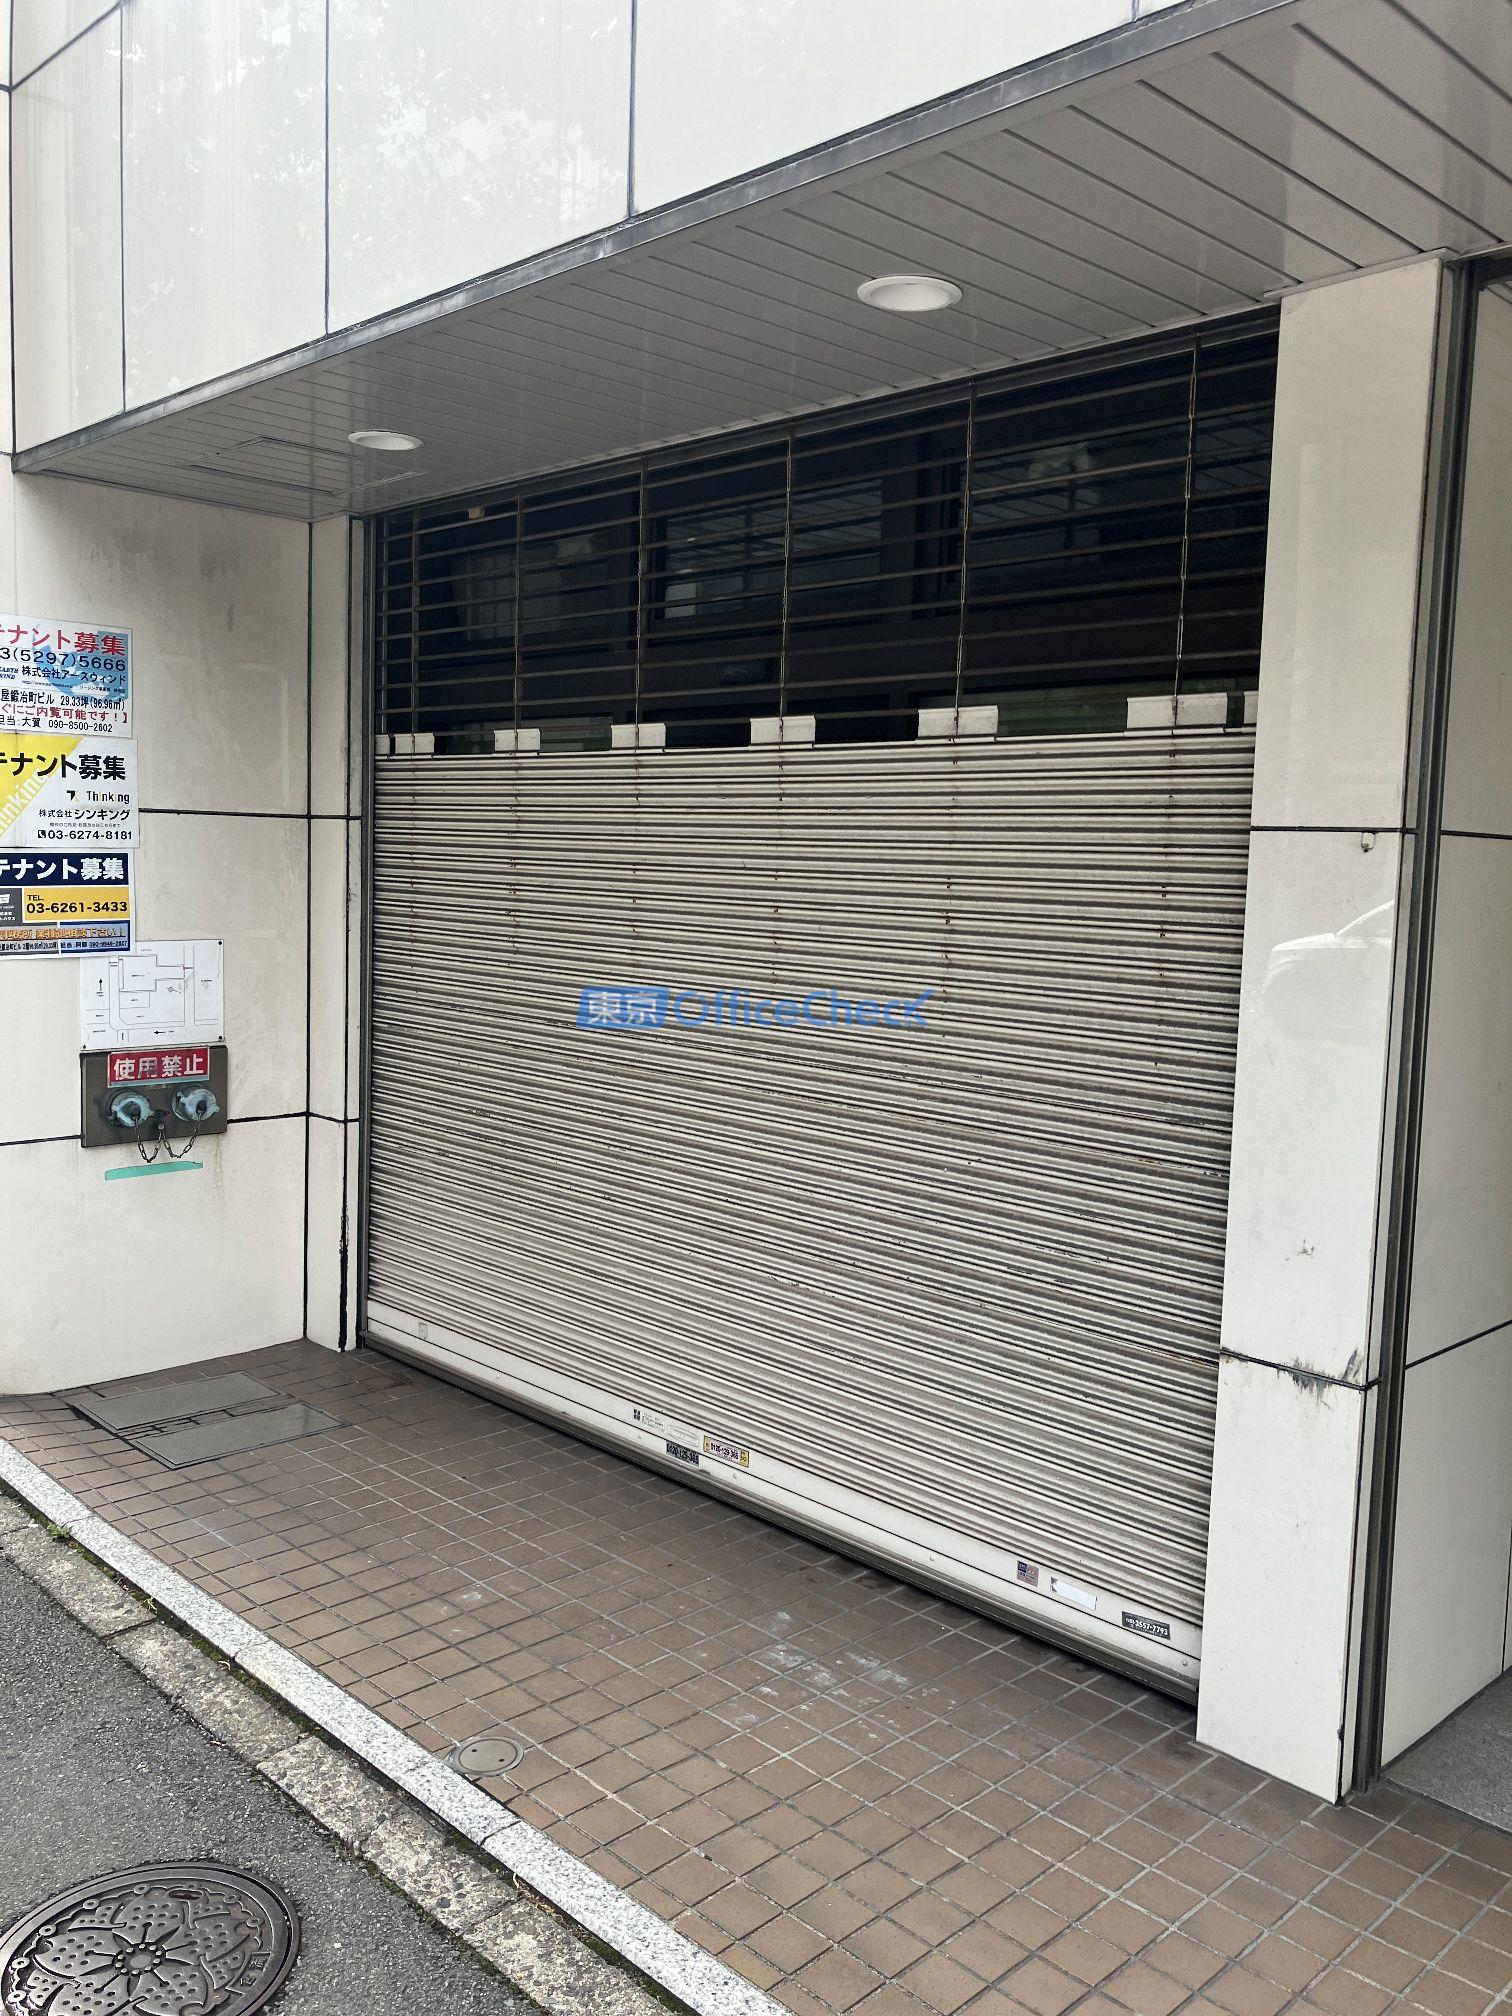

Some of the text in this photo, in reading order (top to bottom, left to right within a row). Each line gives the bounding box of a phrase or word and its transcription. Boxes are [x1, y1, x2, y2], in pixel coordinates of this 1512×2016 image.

[22, 665, 126, 686] 株式会社アースウィンド
[87, 791, 130, 804] Thinking
[38, 808, 130, 820] 株式会社シンキング
[48, 830, 132, 840] 03-6274-8181
[26, 902, 127, 914] 03-6261-3433
[113, 1053, 204, 1081] 使用禁止
